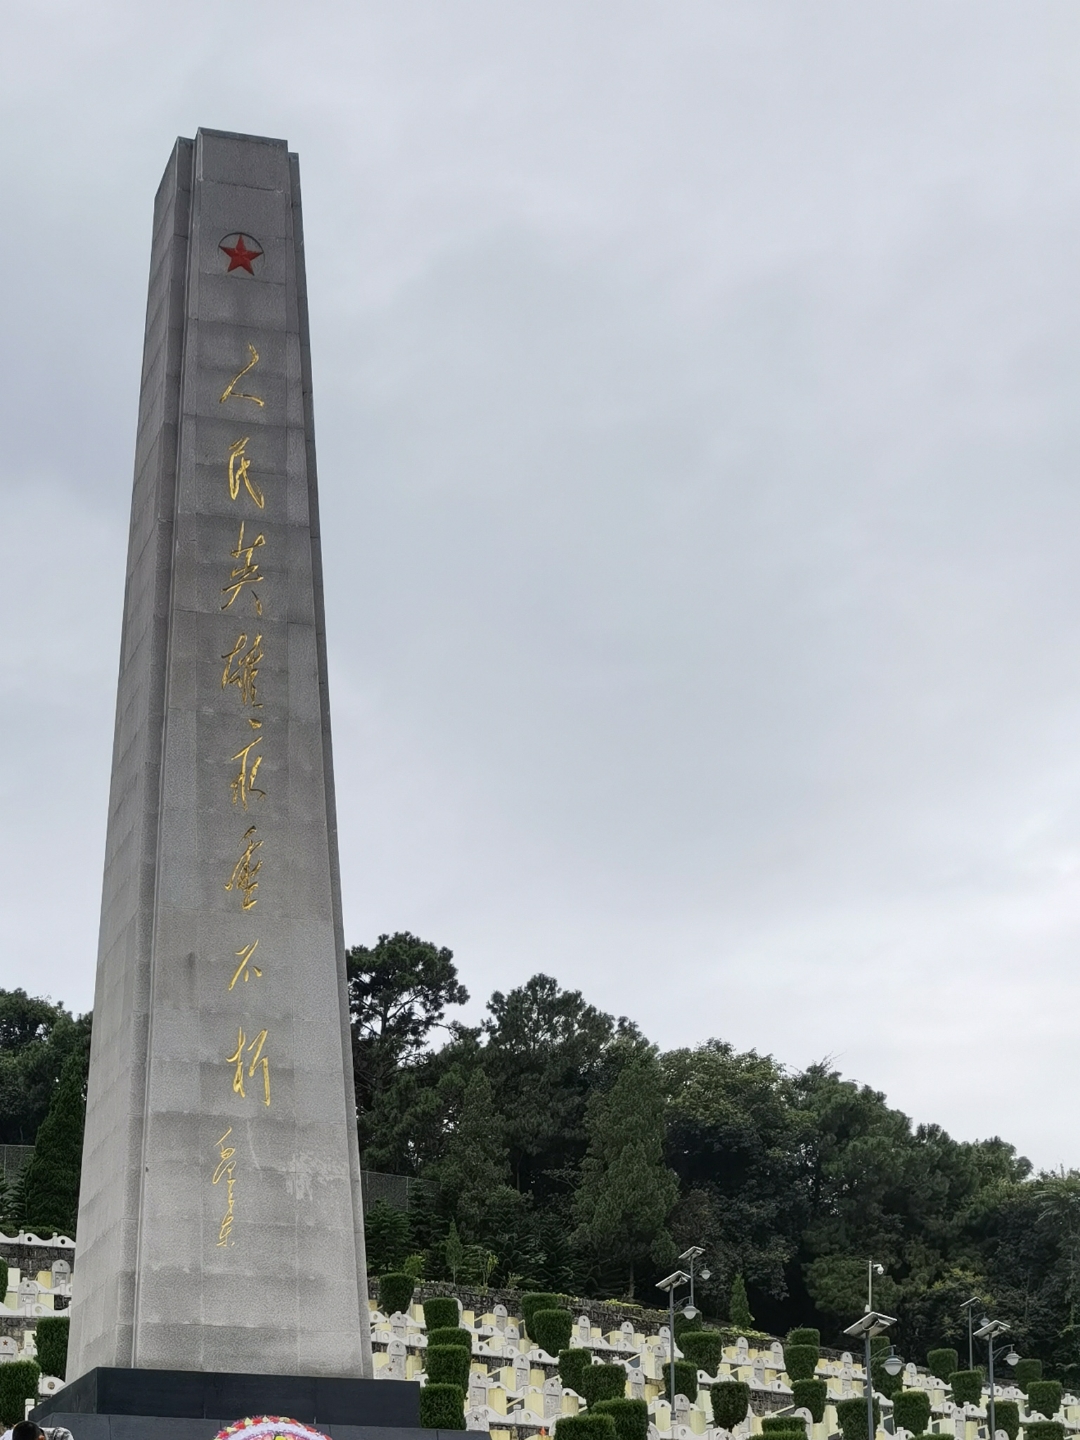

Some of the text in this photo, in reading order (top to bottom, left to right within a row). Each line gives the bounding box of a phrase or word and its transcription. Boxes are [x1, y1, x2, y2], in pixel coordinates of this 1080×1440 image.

[219, 342, 270, 1107] 人民英雄永垂不朽
